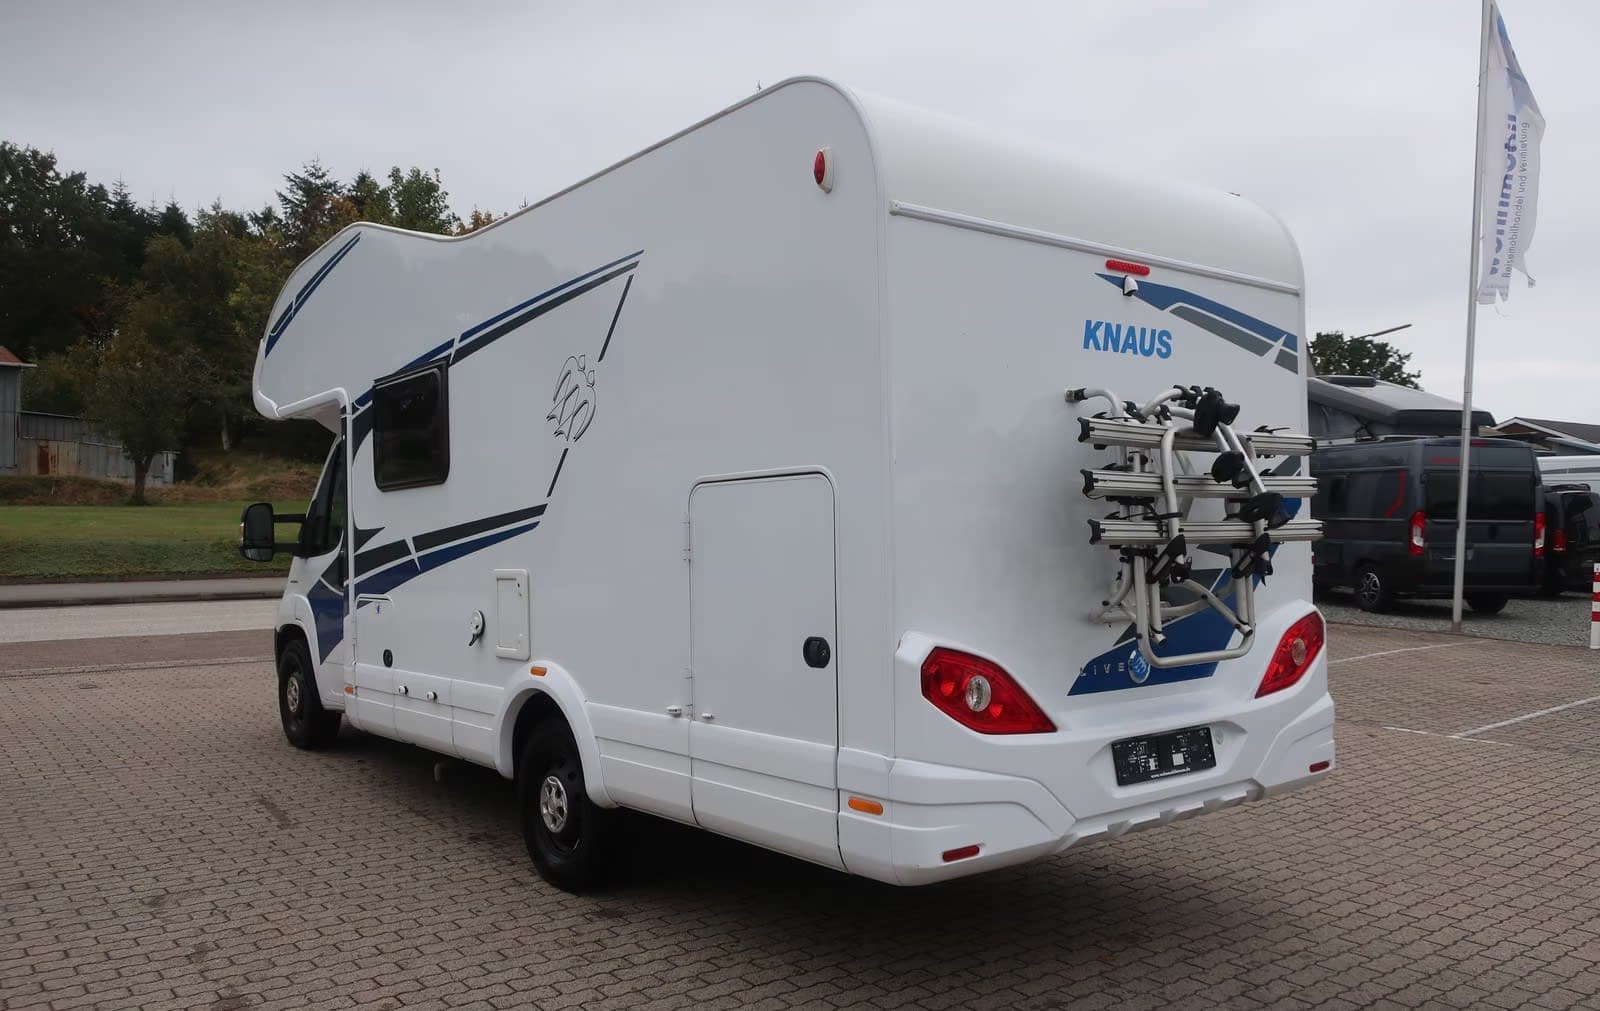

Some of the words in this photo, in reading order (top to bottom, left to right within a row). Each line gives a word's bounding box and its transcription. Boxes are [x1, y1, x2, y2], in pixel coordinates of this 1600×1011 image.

[1519, 121, 1530, 173] Vermietung
[1517, 175, 1528, 193] und
[1501, 195, 1524, 278] Reisemobilhandel
[1083, 319, 1173, 359] KNAUS
